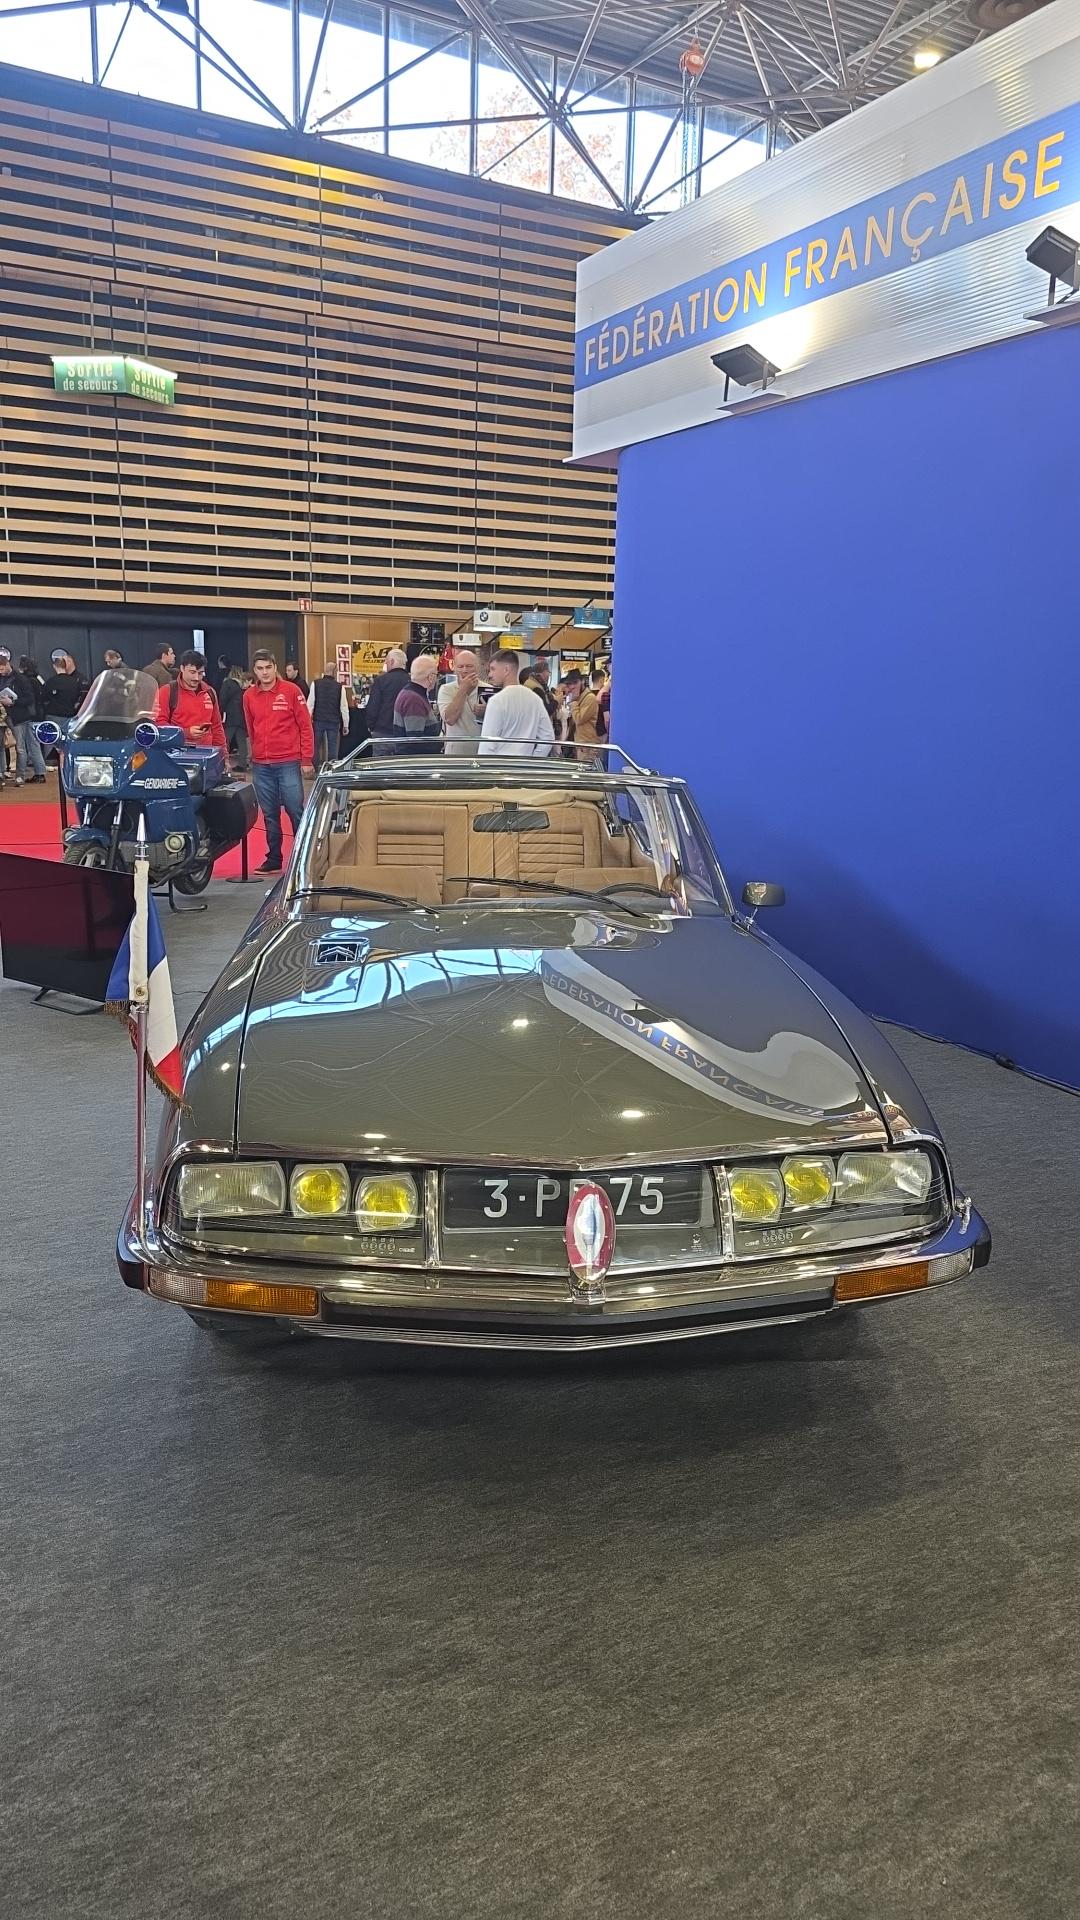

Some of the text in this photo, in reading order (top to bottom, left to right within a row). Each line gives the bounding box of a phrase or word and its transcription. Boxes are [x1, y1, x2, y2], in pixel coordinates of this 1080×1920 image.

[585, 131, 1065, 376] FÉDÉRATION FRANÇAISE
[67, 361, 113, 378] Sortie
[134, 367, 166, 390] Sortie
[63, 378, 118, 391] de secours
[131, 380, 170, 405] de secours
[144, 777, 179, 790] GENDARMERIE
